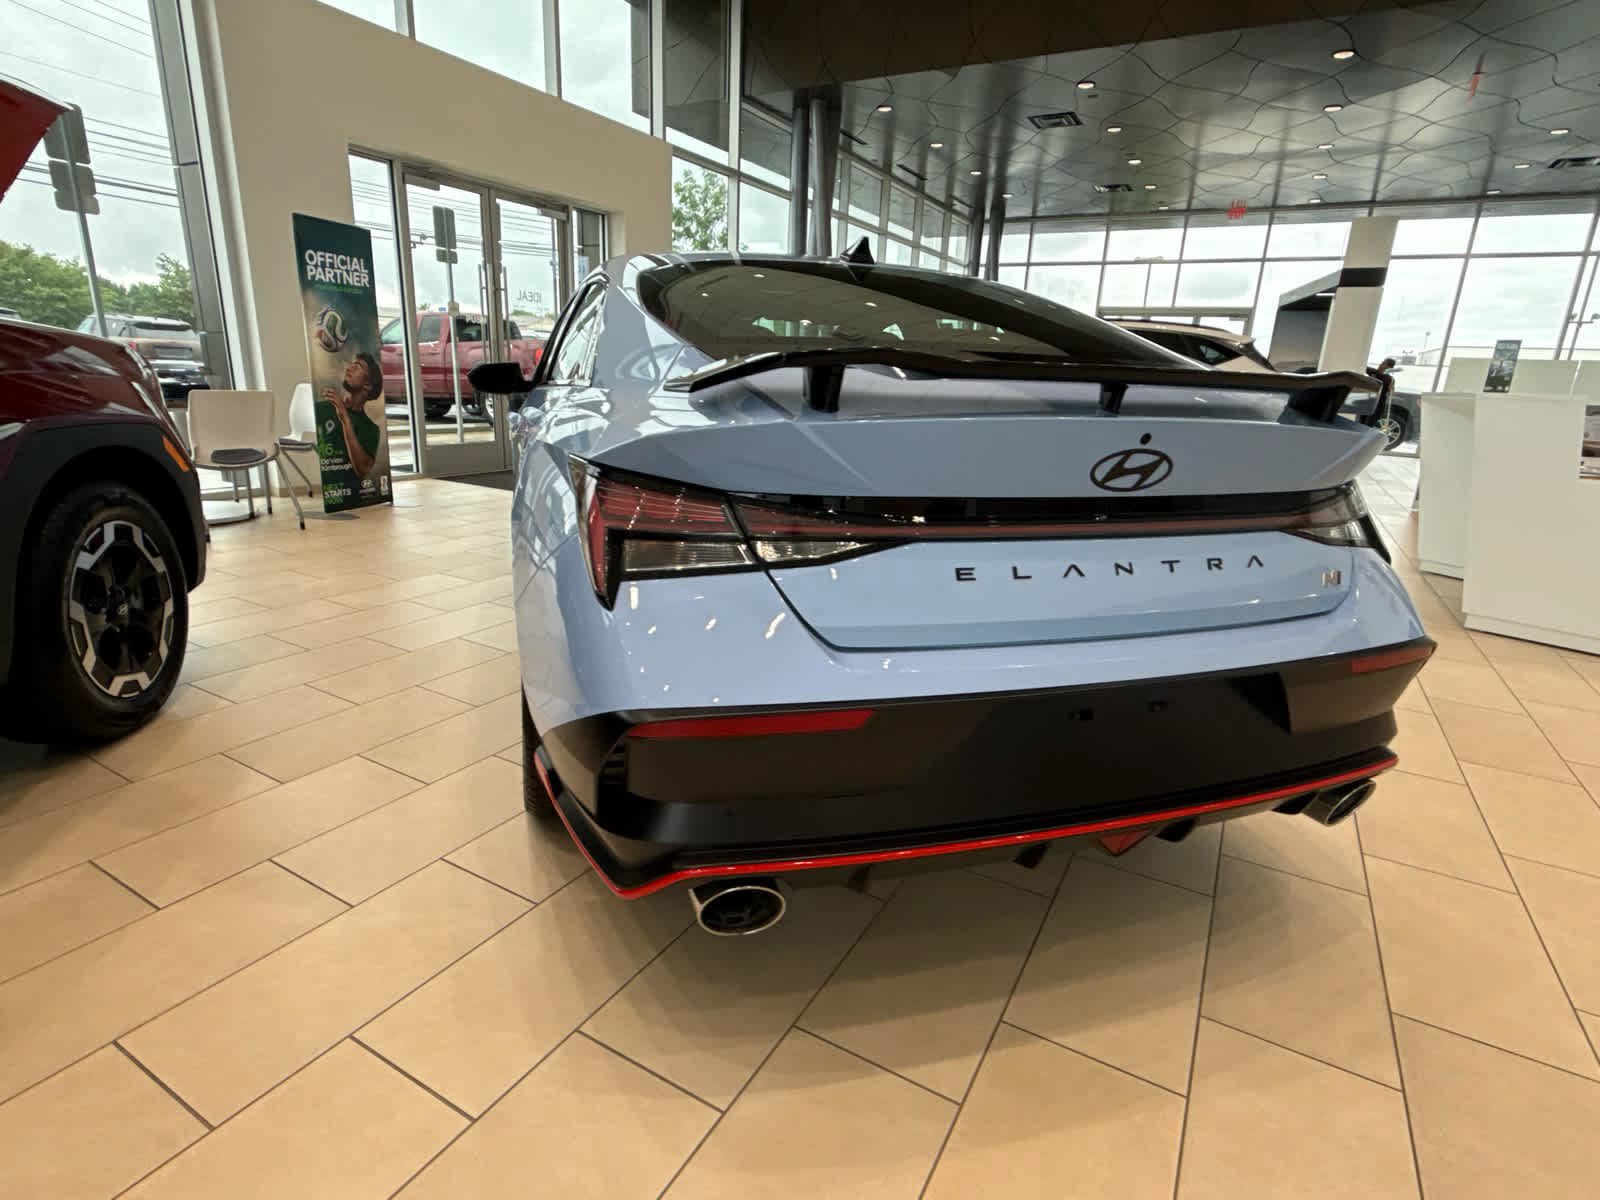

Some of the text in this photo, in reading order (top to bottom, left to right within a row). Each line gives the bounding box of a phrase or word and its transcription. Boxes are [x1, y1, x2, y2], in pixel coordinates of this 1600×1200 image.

[305, 249, 368, 273] OFFICIAL
[306, 265, 369, 288] PARTNER
[325, 488, 352, 499] STARTS
[955, 554, 1265, 582] ELANTRA
